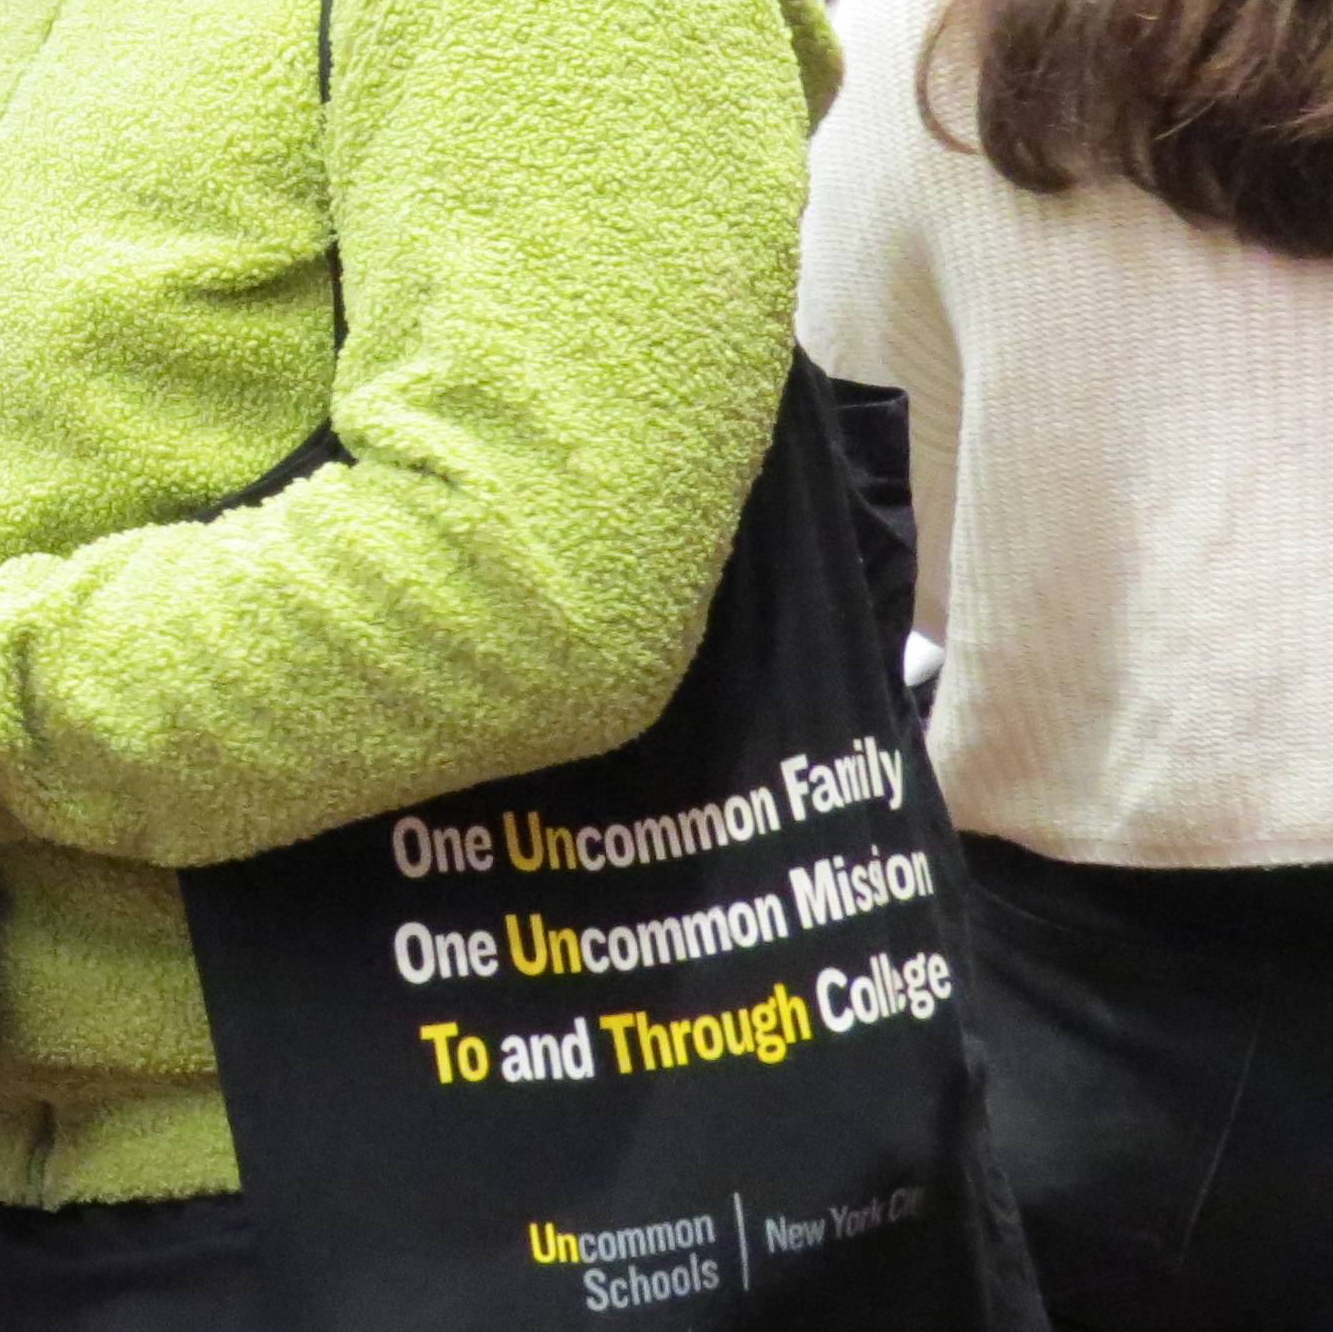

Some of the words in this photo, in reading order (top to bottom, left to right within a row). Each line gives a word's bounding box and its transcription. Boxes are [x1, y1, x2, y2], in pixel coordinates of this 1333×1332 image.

[393, 817, 494, 878] One
[503, 786, 782, 872] Uncommon
[780, 736, 904, 822] Family
[394, 922, 499, 984] One
[505, 893, 789, 976] Uncommon
[789, 844, 933, 930] Mission
[420, 1022, 489, 1084] To
[500, 1017, 595, 1083] and
[599, 983, 813, 1074] Through
[529, 1214, 716, 1264] Uncommon
[765, 1215, 826, 1254] New
[829, 1196, 883, 1239] York
[583, 1252, 720, 1312] Schools
